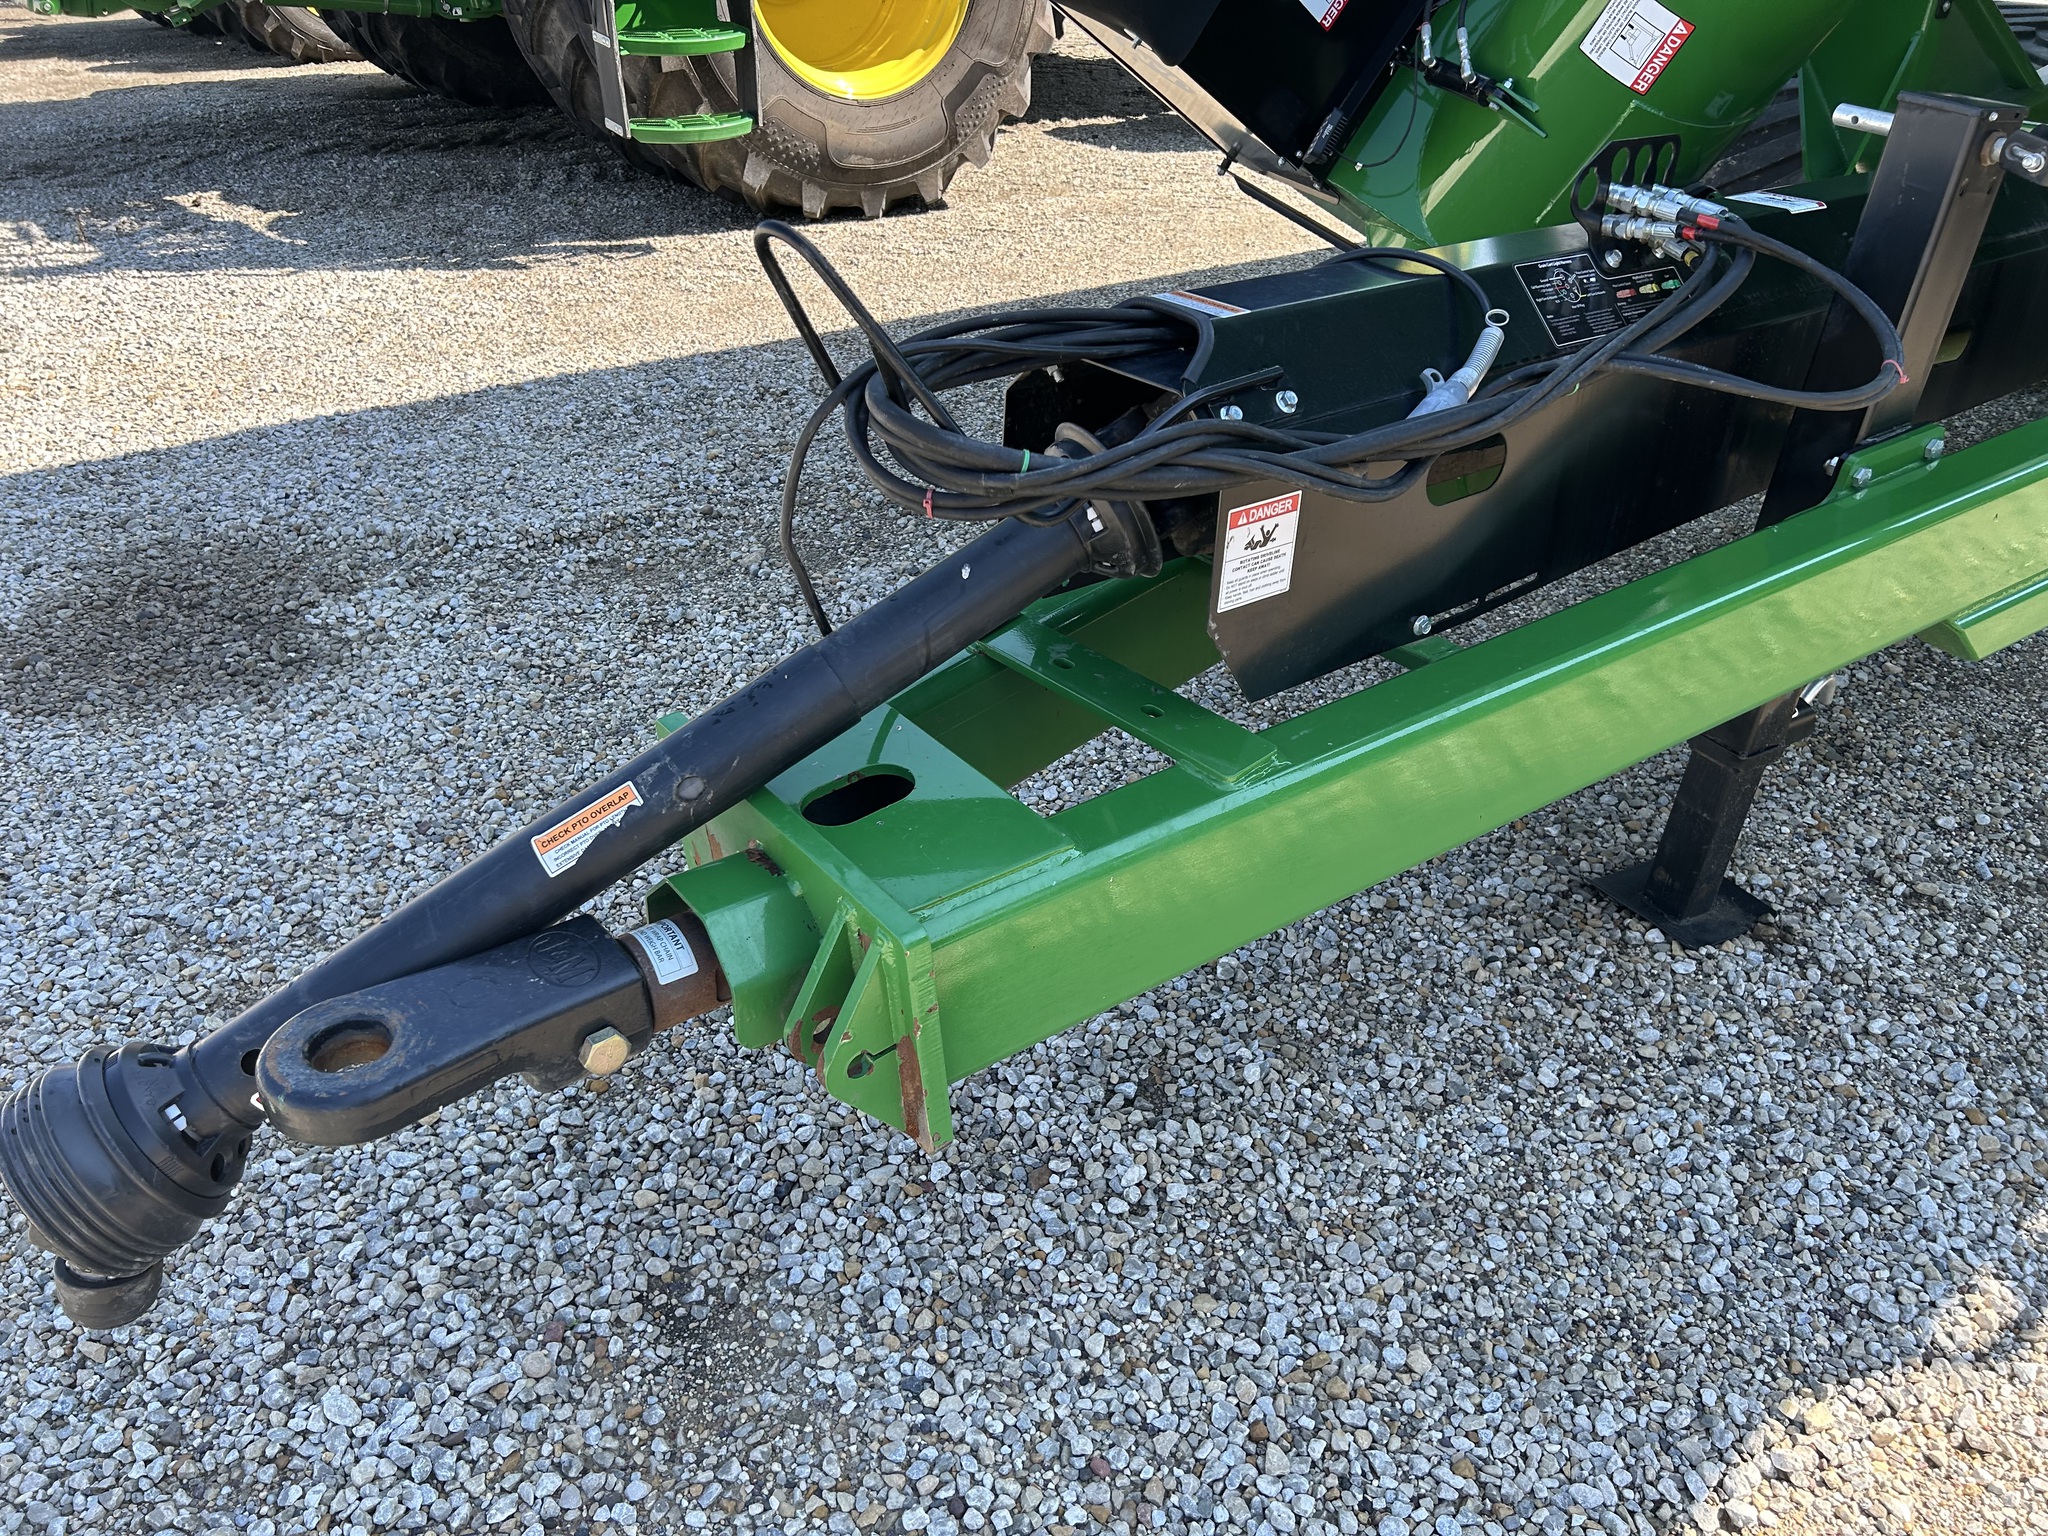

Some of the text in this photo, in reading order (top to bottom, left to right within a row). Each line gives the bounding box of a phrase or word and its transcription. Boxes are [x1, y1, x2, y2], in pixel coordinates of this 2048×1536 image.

[1633, 35, 1682, 92] DANGER
[1249, 498, 1293, 521] DANGER
[541, 827, 571, 849] CHECK
[572, 816, 589, 830] PTO
[590, 791, 629, 819] OVERLAP
[554, 843, 570, 854] CHECK
[570, 831, 590, 844] MANUAL
[600, 818, 609, 827] PTO
[553, 844, 580, 862] INCORRECT
[580, 838, 590, 846] PTO
[556, 851, 580, 867] EXTENSIVE
[644, 934, 658, 950] WEIGH
[655, 950, 665, 963] BAR
[660, 941, 674, 961] CHAIN
